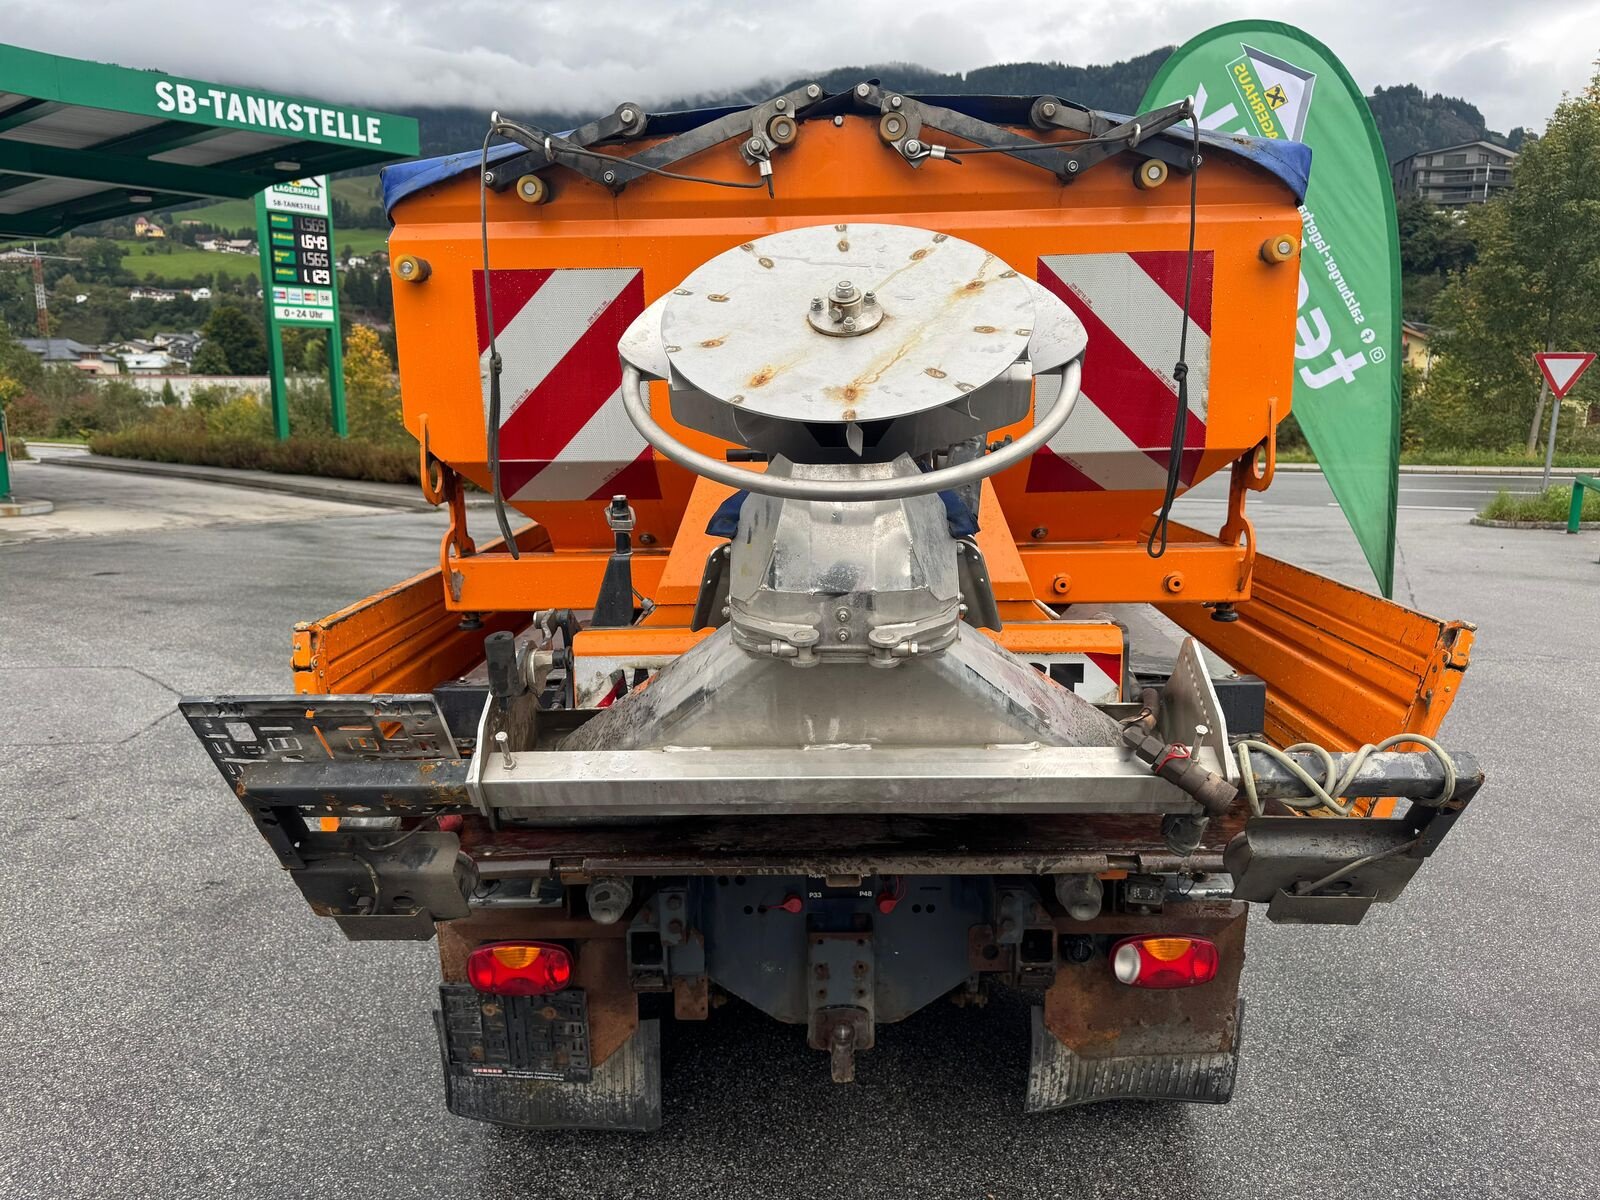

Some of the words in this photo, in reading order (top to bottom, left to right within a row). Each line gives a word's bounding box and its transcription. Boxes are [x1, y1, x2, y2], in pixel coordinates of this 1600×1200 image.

[155, 81, 382, 144] SB-TANKSTELLE
[273, 184, 319, 197] LAGERHAUS
[273, 200, 320, 211] SB-TANKSTELLE
[301, 234, 328, 250] 1.649
[303, 252, 328, 267] 1.565
[309, 310, 323, 319] Uhr
